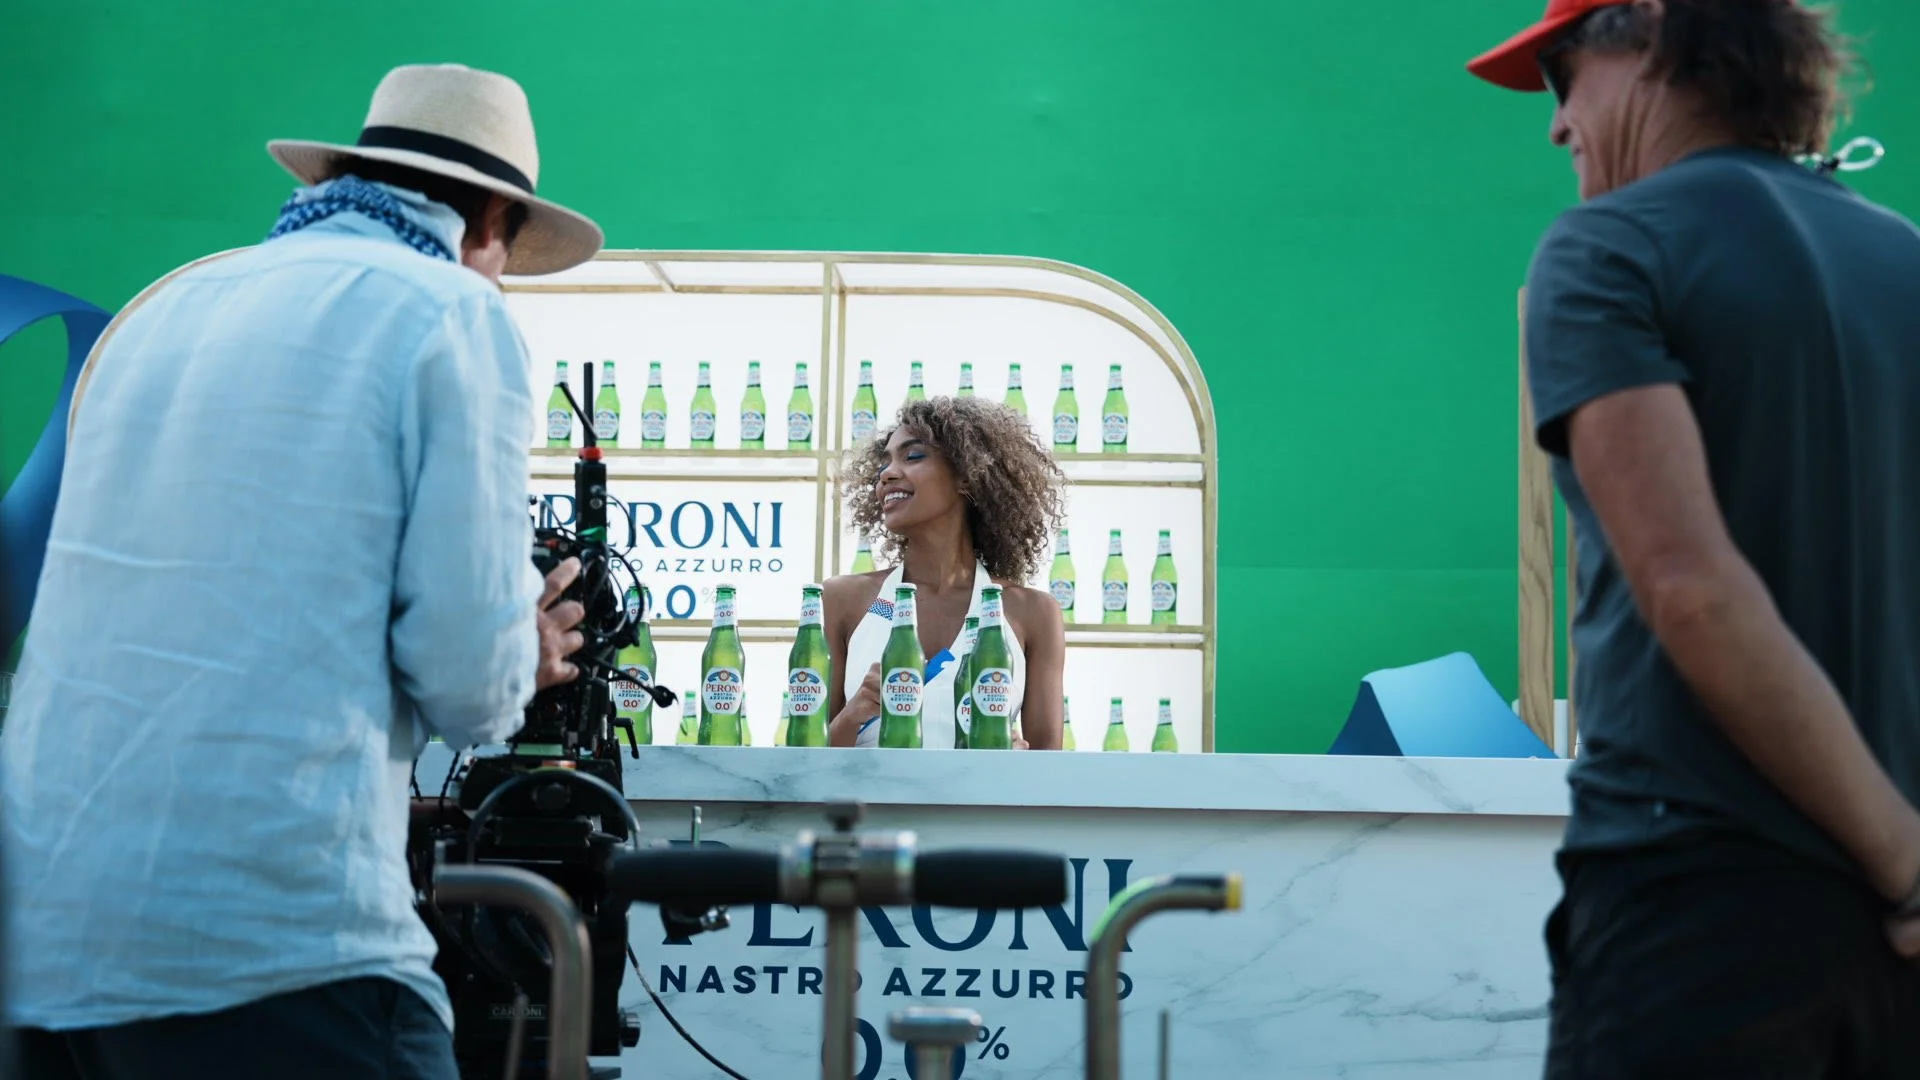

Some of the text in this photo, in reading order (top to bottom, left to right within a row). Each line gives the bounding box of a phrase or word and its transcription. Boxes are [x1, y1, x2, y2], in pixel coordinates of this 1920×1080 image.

[542, 494, 783, 549] PRONI
[655, 558, 783, 572] AZZURRO
[705, 683, 741, 693] PERONI
[788, 684, 821, 694] PERONI
[977, 685, 1010, 694] PERON
[492, 1006, 542, 1017] CARONI
